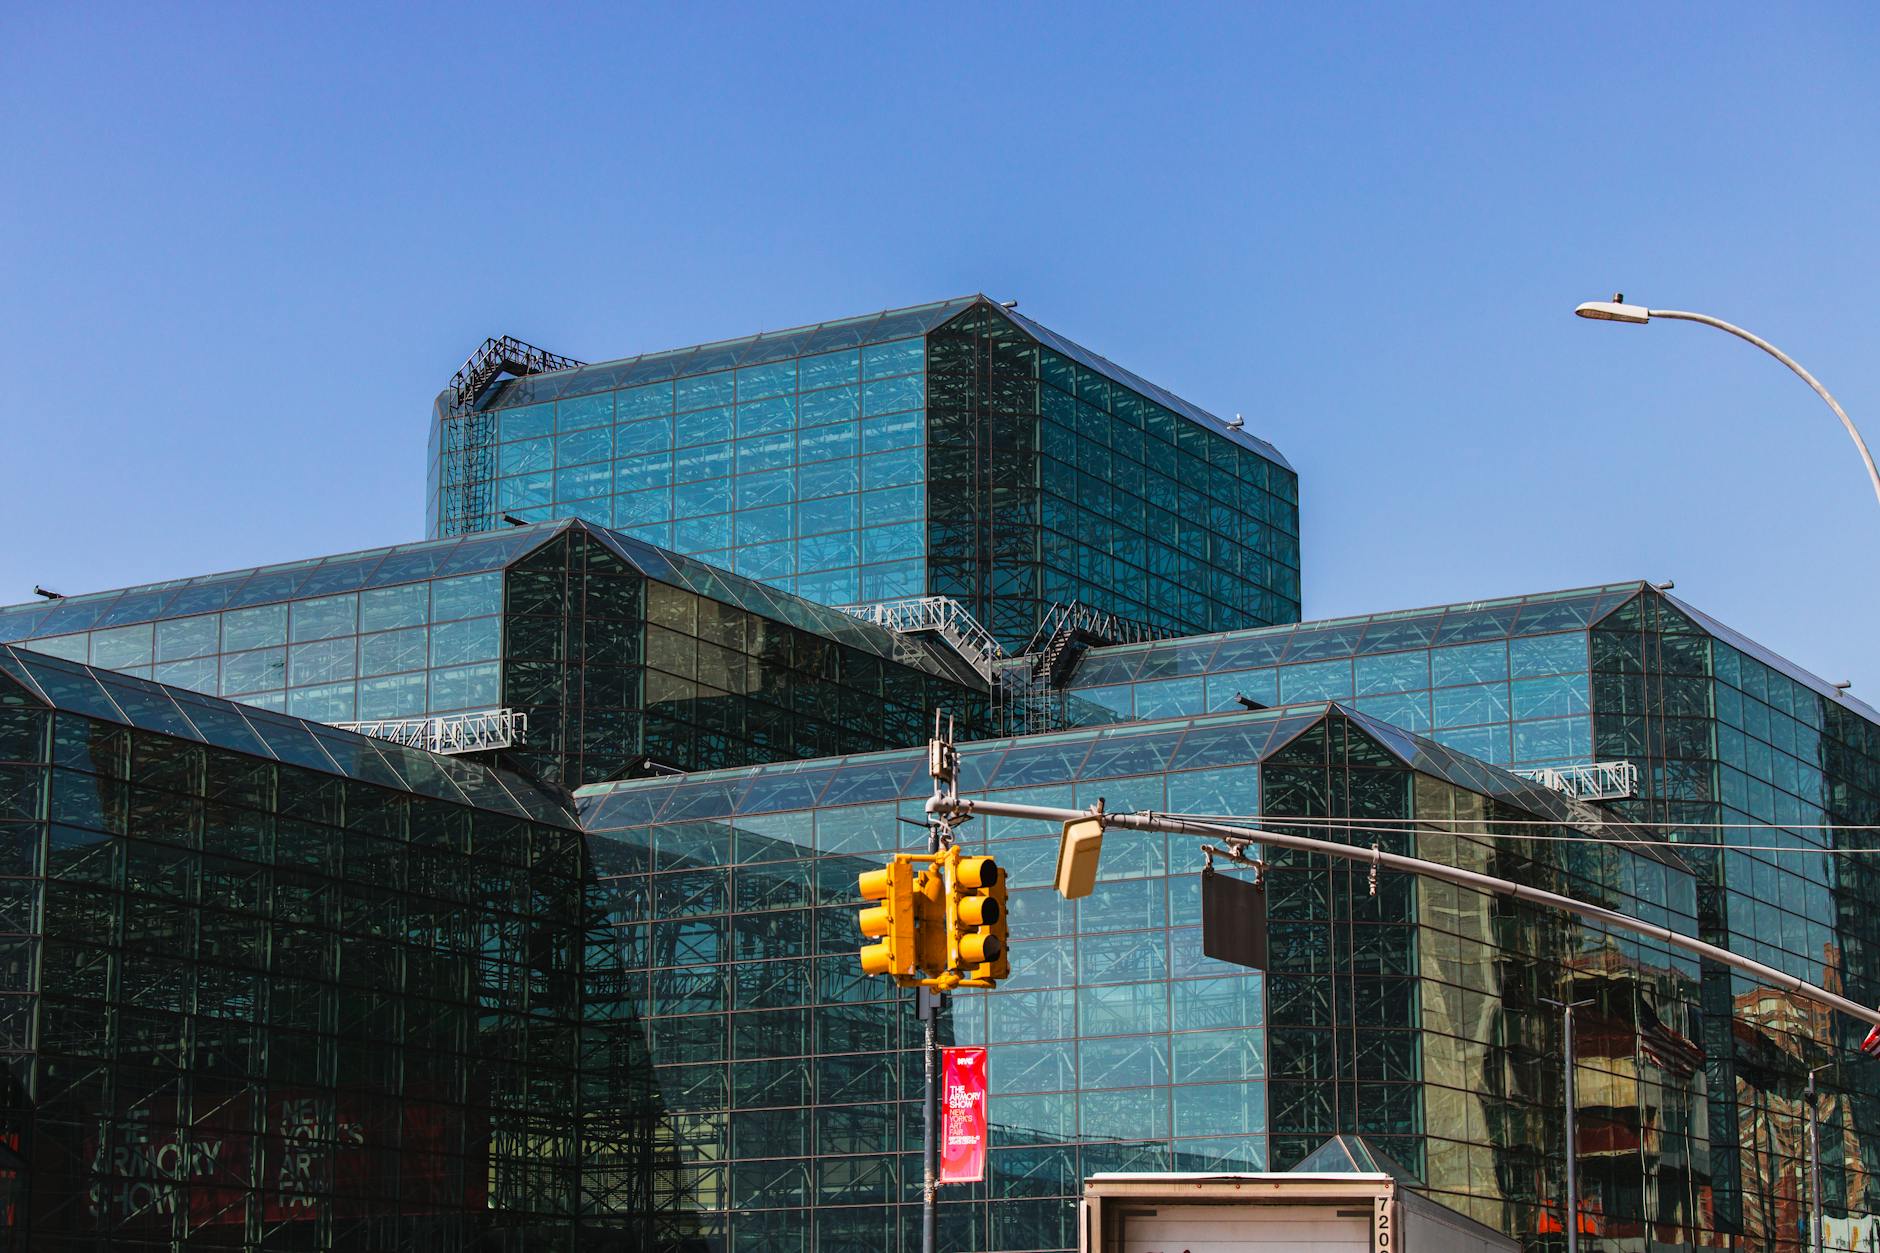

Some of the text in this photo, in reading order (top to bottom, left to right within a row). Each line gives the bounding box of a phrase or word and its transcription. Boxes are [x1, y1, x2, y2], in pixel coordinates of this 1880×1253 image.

[949, 1085, 965, 1094] THE
[949, 1091, 981, 1101] ARMORY
[950, 1100, 974, 1109] SHOW
[950, 1115, 973, 1123] YORK'S
[950, 1122, 963, 1130] ART
[1378, 1197, 1389, 1253] 720
